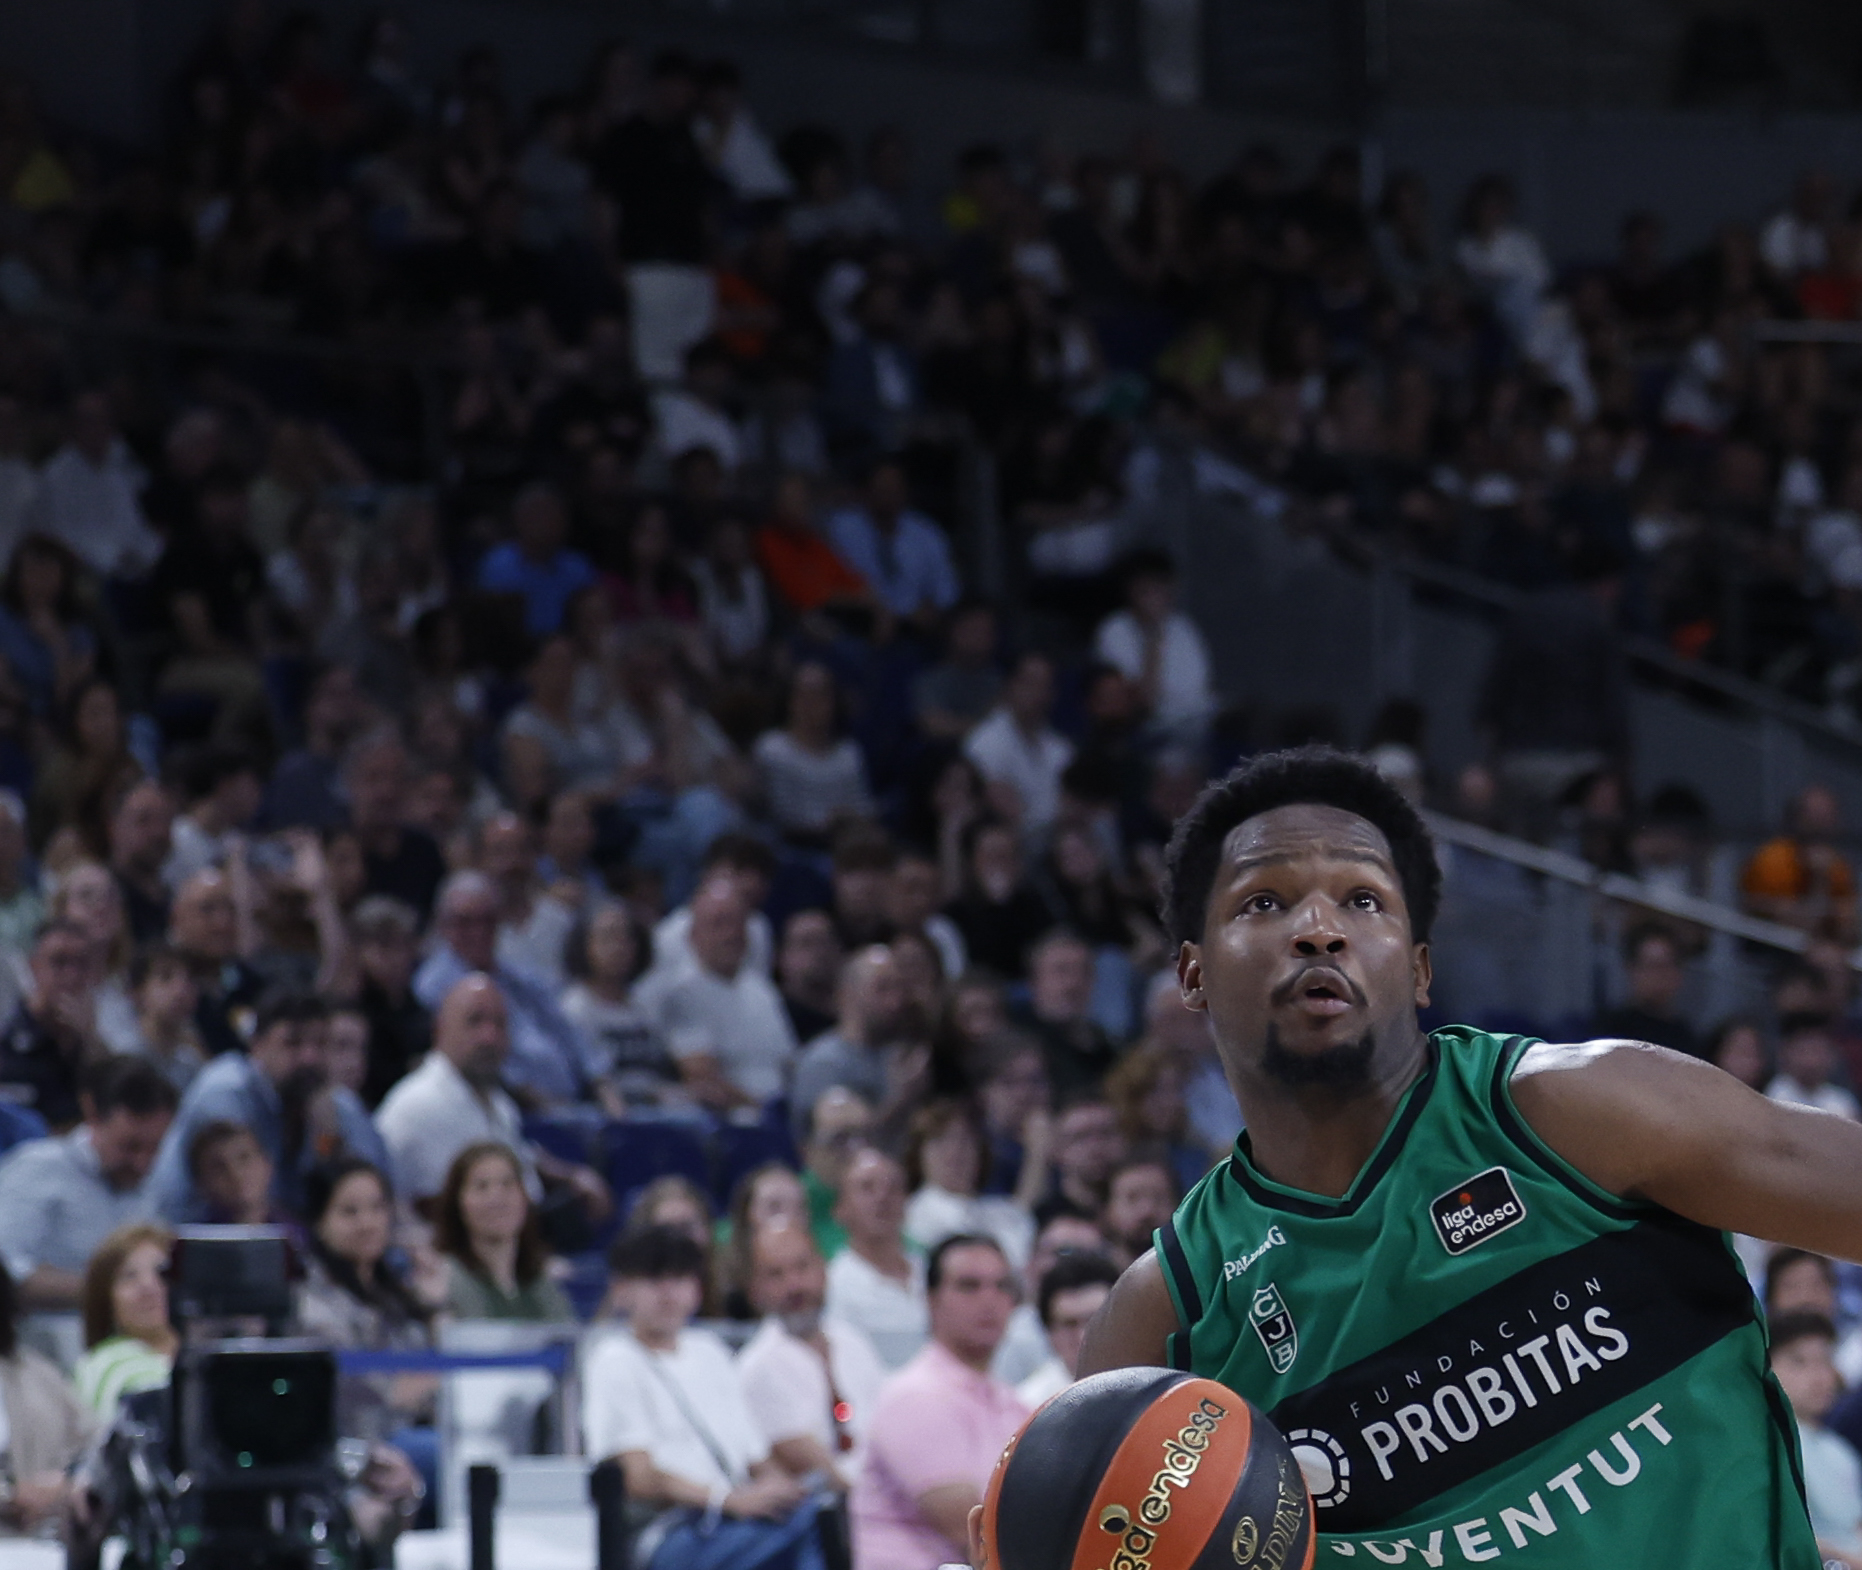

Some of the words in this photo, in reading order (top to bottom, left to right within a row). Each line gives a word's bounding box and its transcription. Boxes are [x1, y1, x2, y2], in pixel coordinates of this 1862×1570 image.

[1441, 1205, 1475, 1230] liga
[1451, 1201, 1518, 1244] endesa
[1350, 1277, 1602, 1419] FUNDACIÓN
[1360, 1305, 1629, 1482] PROBITAS
[1138, 1397, 1228, 1526] endesa
